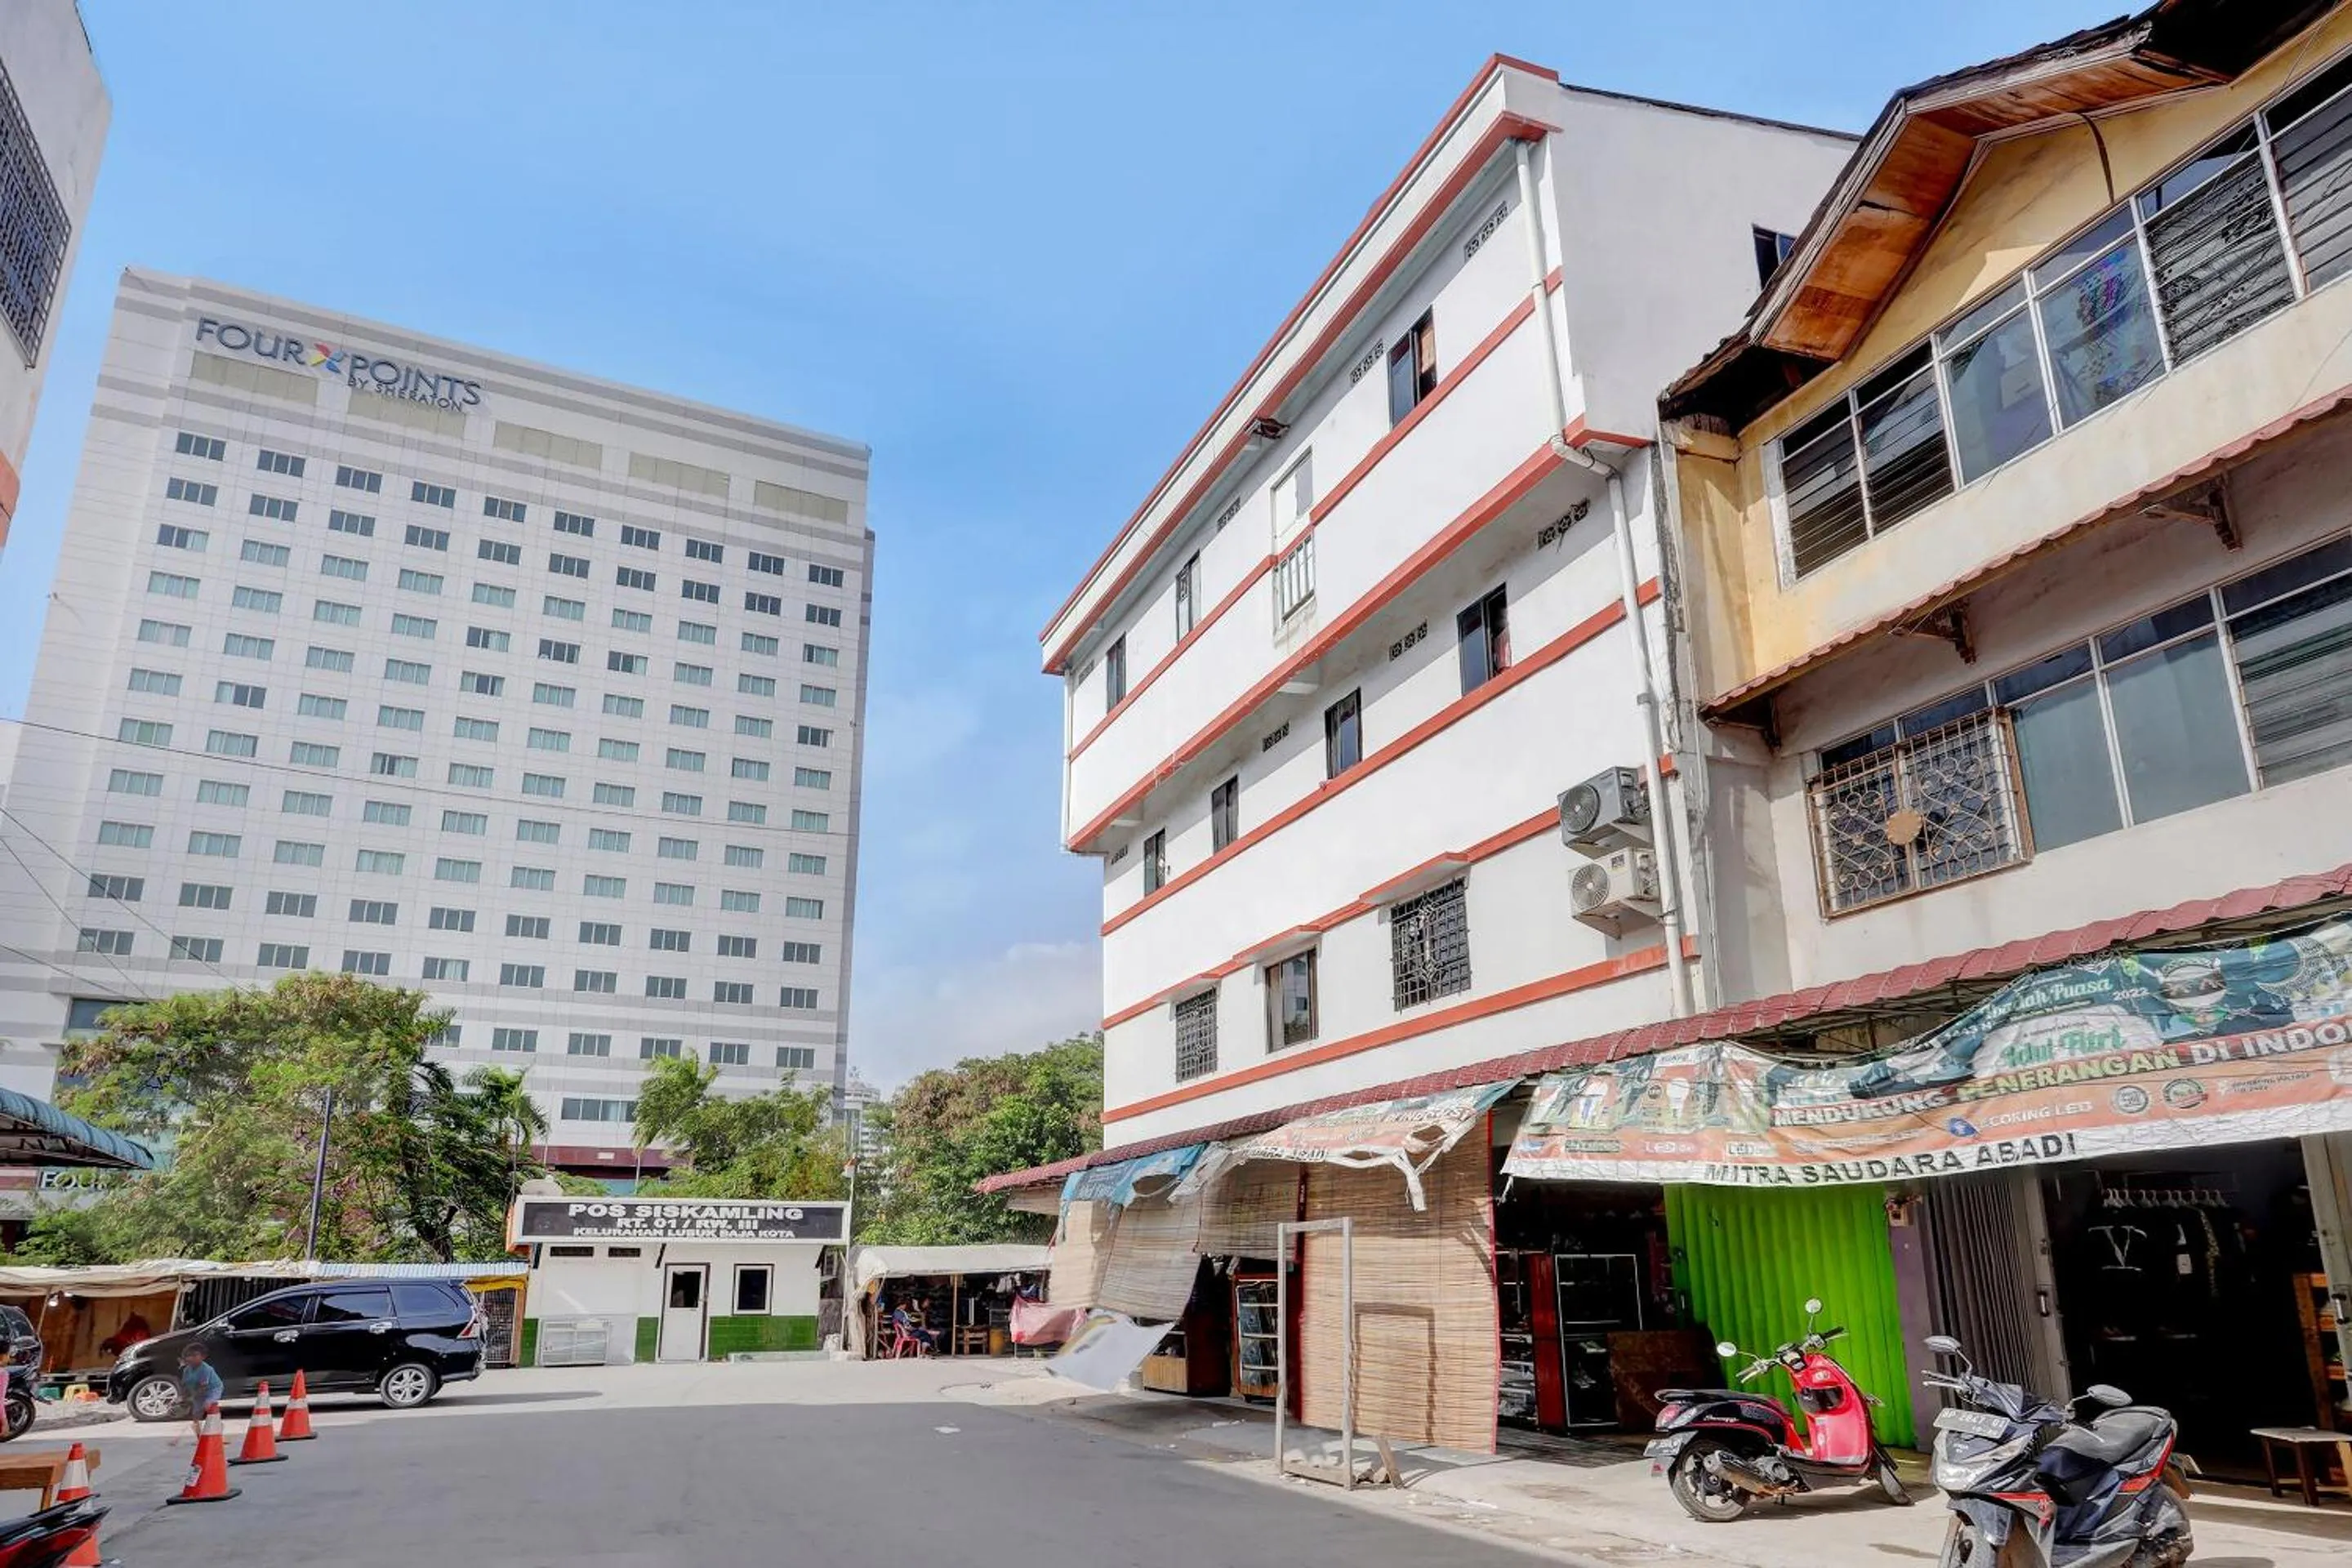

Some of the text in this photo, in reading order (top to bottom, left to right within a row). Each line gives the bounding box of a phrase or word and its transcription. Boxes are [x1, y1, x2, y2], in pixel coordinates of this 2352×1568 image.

[197, 317, 481, 405] FOUR POINTS
[348, 376, 462, 412] BY SHERATON
[1775, 1089, 1946, 1126] MENDUKUNG
[2189, 1040, 2232, 1064] DI
[1704, 1132, 2076, 1184] MITRA SAUDARA ABADI
[568, 1203, 804, 1220] POS SISKAMLING
[617, 1218, 648, 1228] RT.
[654, 1218, 677, 1228] 01
[696, 1219, 733, 1229] RW.
[738, 1220, 759, 1230] III
[573, 1227, 795, 1239] KELURAHAN LUBUK BAJA KOTA
